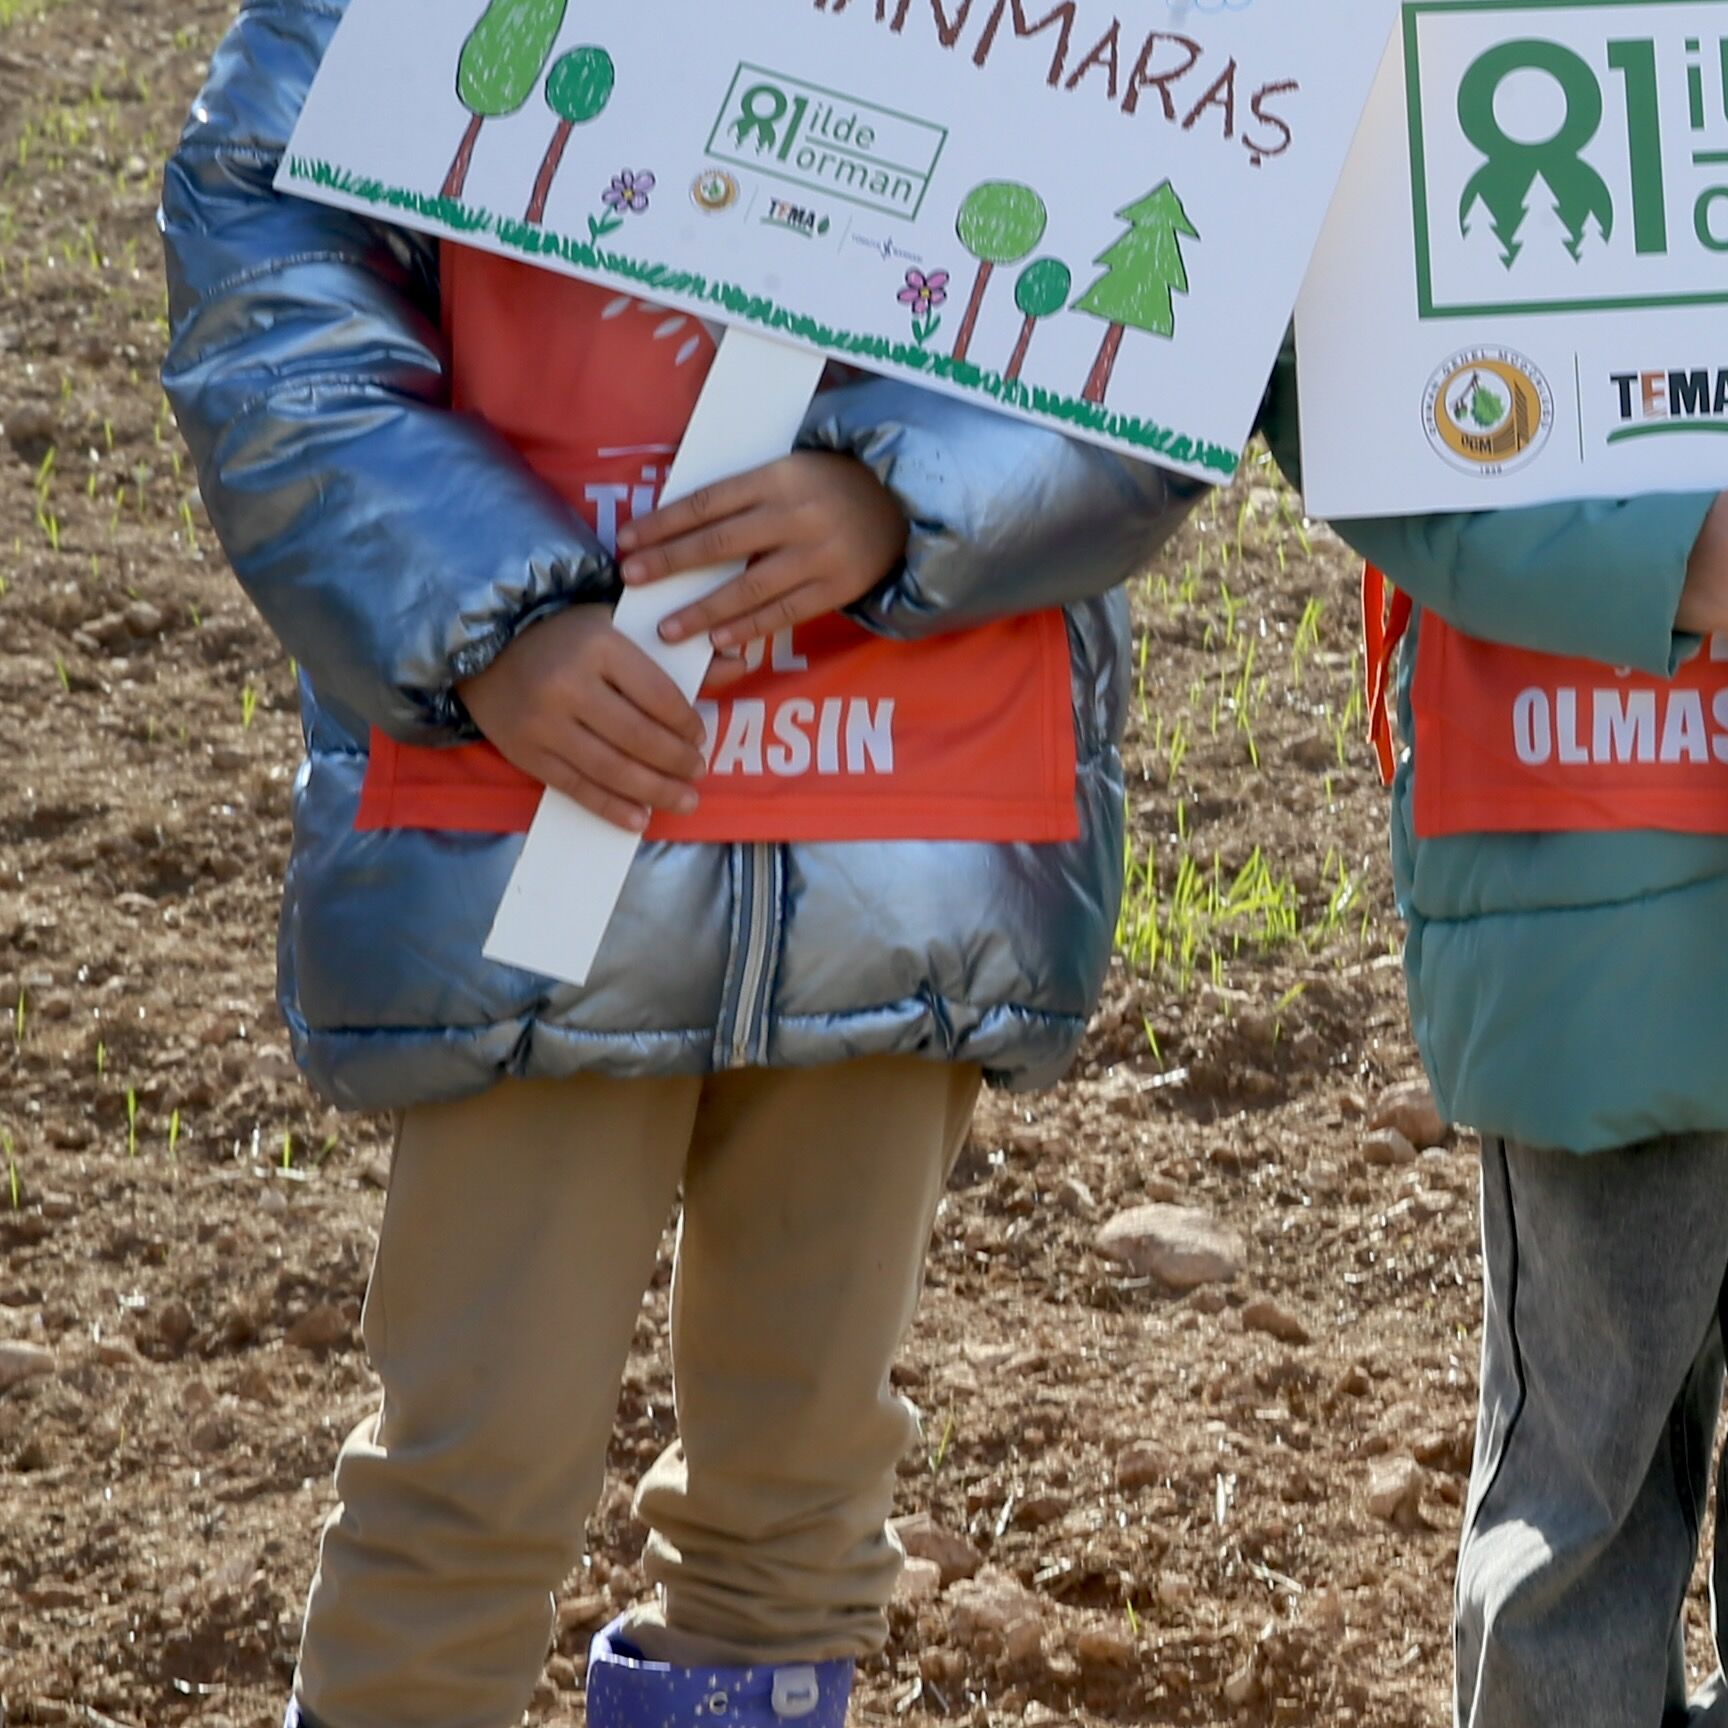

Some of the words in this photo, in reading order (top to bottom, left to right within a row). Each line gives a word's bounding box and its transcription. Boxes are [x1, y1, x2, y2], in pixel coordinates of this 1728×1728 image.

[808, 101, 876, 150] ilde
[1457, 38, 1668, 270] 81
[796, 145, 913, 203] orman
[769, 197, 816, 229] TEMA
[694, 695, 895, 777] ASIN
